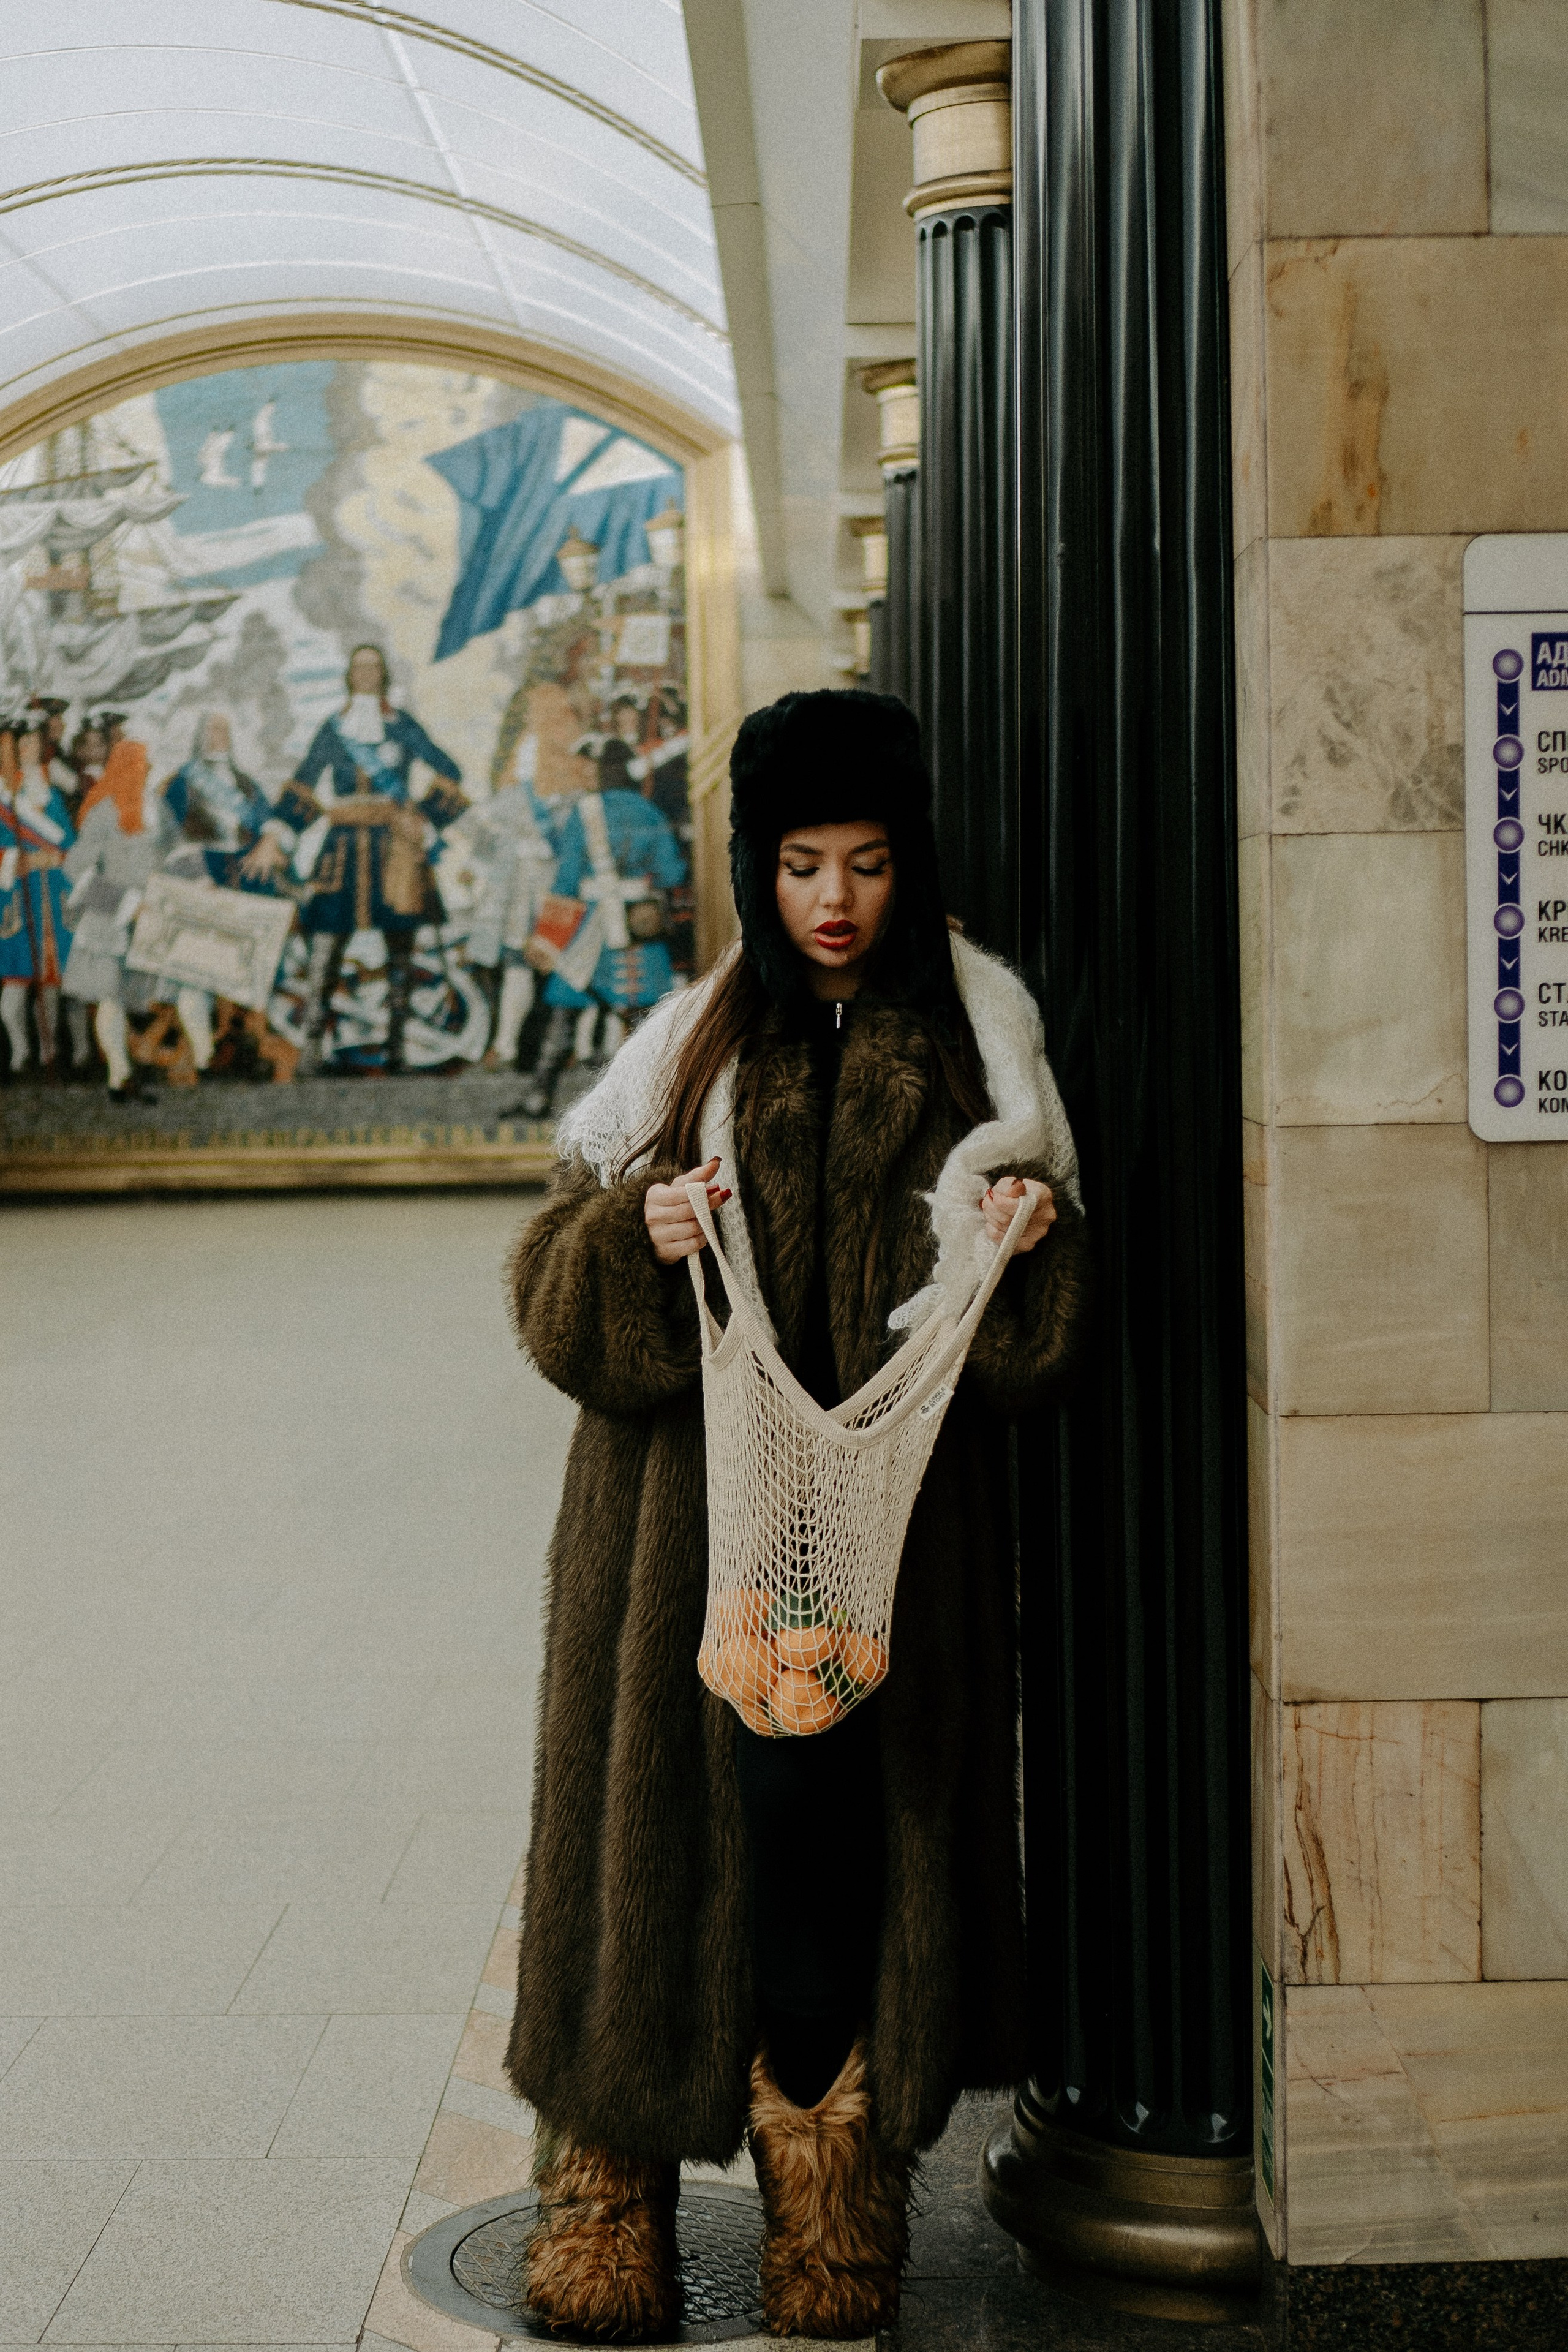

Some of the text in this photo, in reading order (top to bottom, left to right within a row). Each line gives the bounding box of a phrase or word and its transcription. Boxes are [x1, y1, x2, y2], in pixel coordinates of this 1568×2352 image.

[1537, 731, 1566, 752] СП
[1537, 757, 1568, 774] SPO
[1538, 813, 1568, 835] ЧК
[1537, 840, 1568, 856] CHK
[1538, 900, 1567, 921] КР
[1538, 926, 1568, 943] KRE
[1538, 982, 1568, 1004] СТ
[1538, 1011, 1568, 1027] STA
[1538, 1069, 1568, 1091] КО
[930, 1391, 946, 1408] STORY
